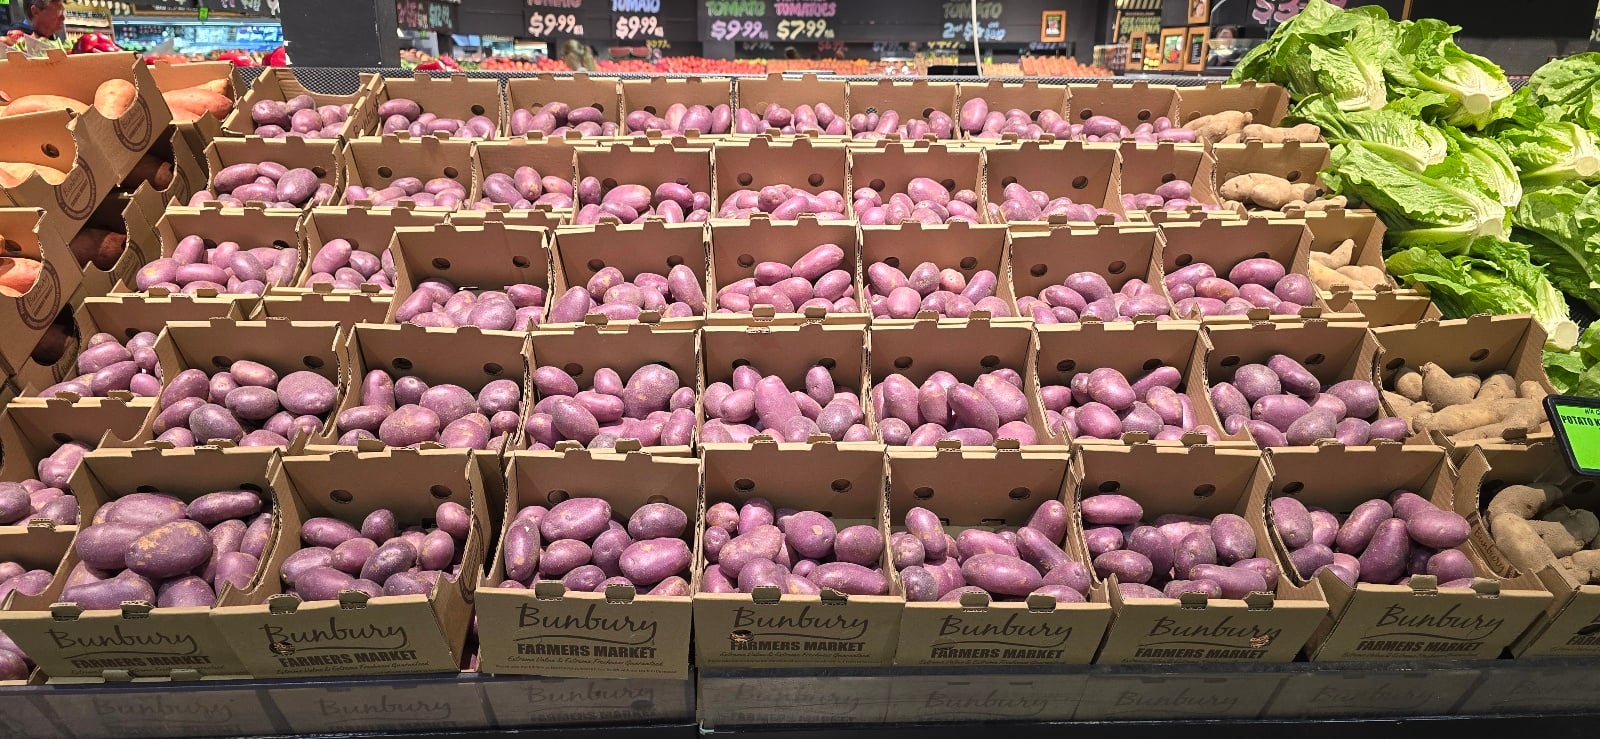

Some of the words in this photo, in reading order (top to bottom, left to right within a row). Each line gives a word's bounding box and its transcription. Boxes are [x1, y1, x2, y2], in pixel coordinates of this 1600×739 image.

[774, 2, 837, 17] TOMATOES
[1562, 415, 1594, 426] POTATO
[514, 602, 658, 645] Bunbury
[732, 605, 869, 640] Bunbury
[1146, 615, 1283, 642] Bunbury
[1376, 602, 1505, 640] Bunbury
[258, 617, 407, 650] Bunbury
[938, 613, 1073, 648] Bunbury
[44, 625, 198, 655] Bunbury
[730, 640, 800, 651] FARMERS
[804, 642, 866, 651] MARKET
[1356, 640, 1425, 651] FARMERS
[1423, 641, 1485, 652] MARKET
[278, 653, 355, 667] FARMERS
[354, 650, 417, 662] MARKET
[517, 643, 590, 657] FARMERS
[593, 645, 657, 659] MARKET
[930, 647, 1001, 659] FARMERS
[1002, 649, 1066, 659] MARKET
[1134, 647, 1201, 658] FARMERS
[1205, 649, 1270, 659] MARKET
[71, 657, 147, 669] FARMERS
[147, 655, 212, 667] MARKET
